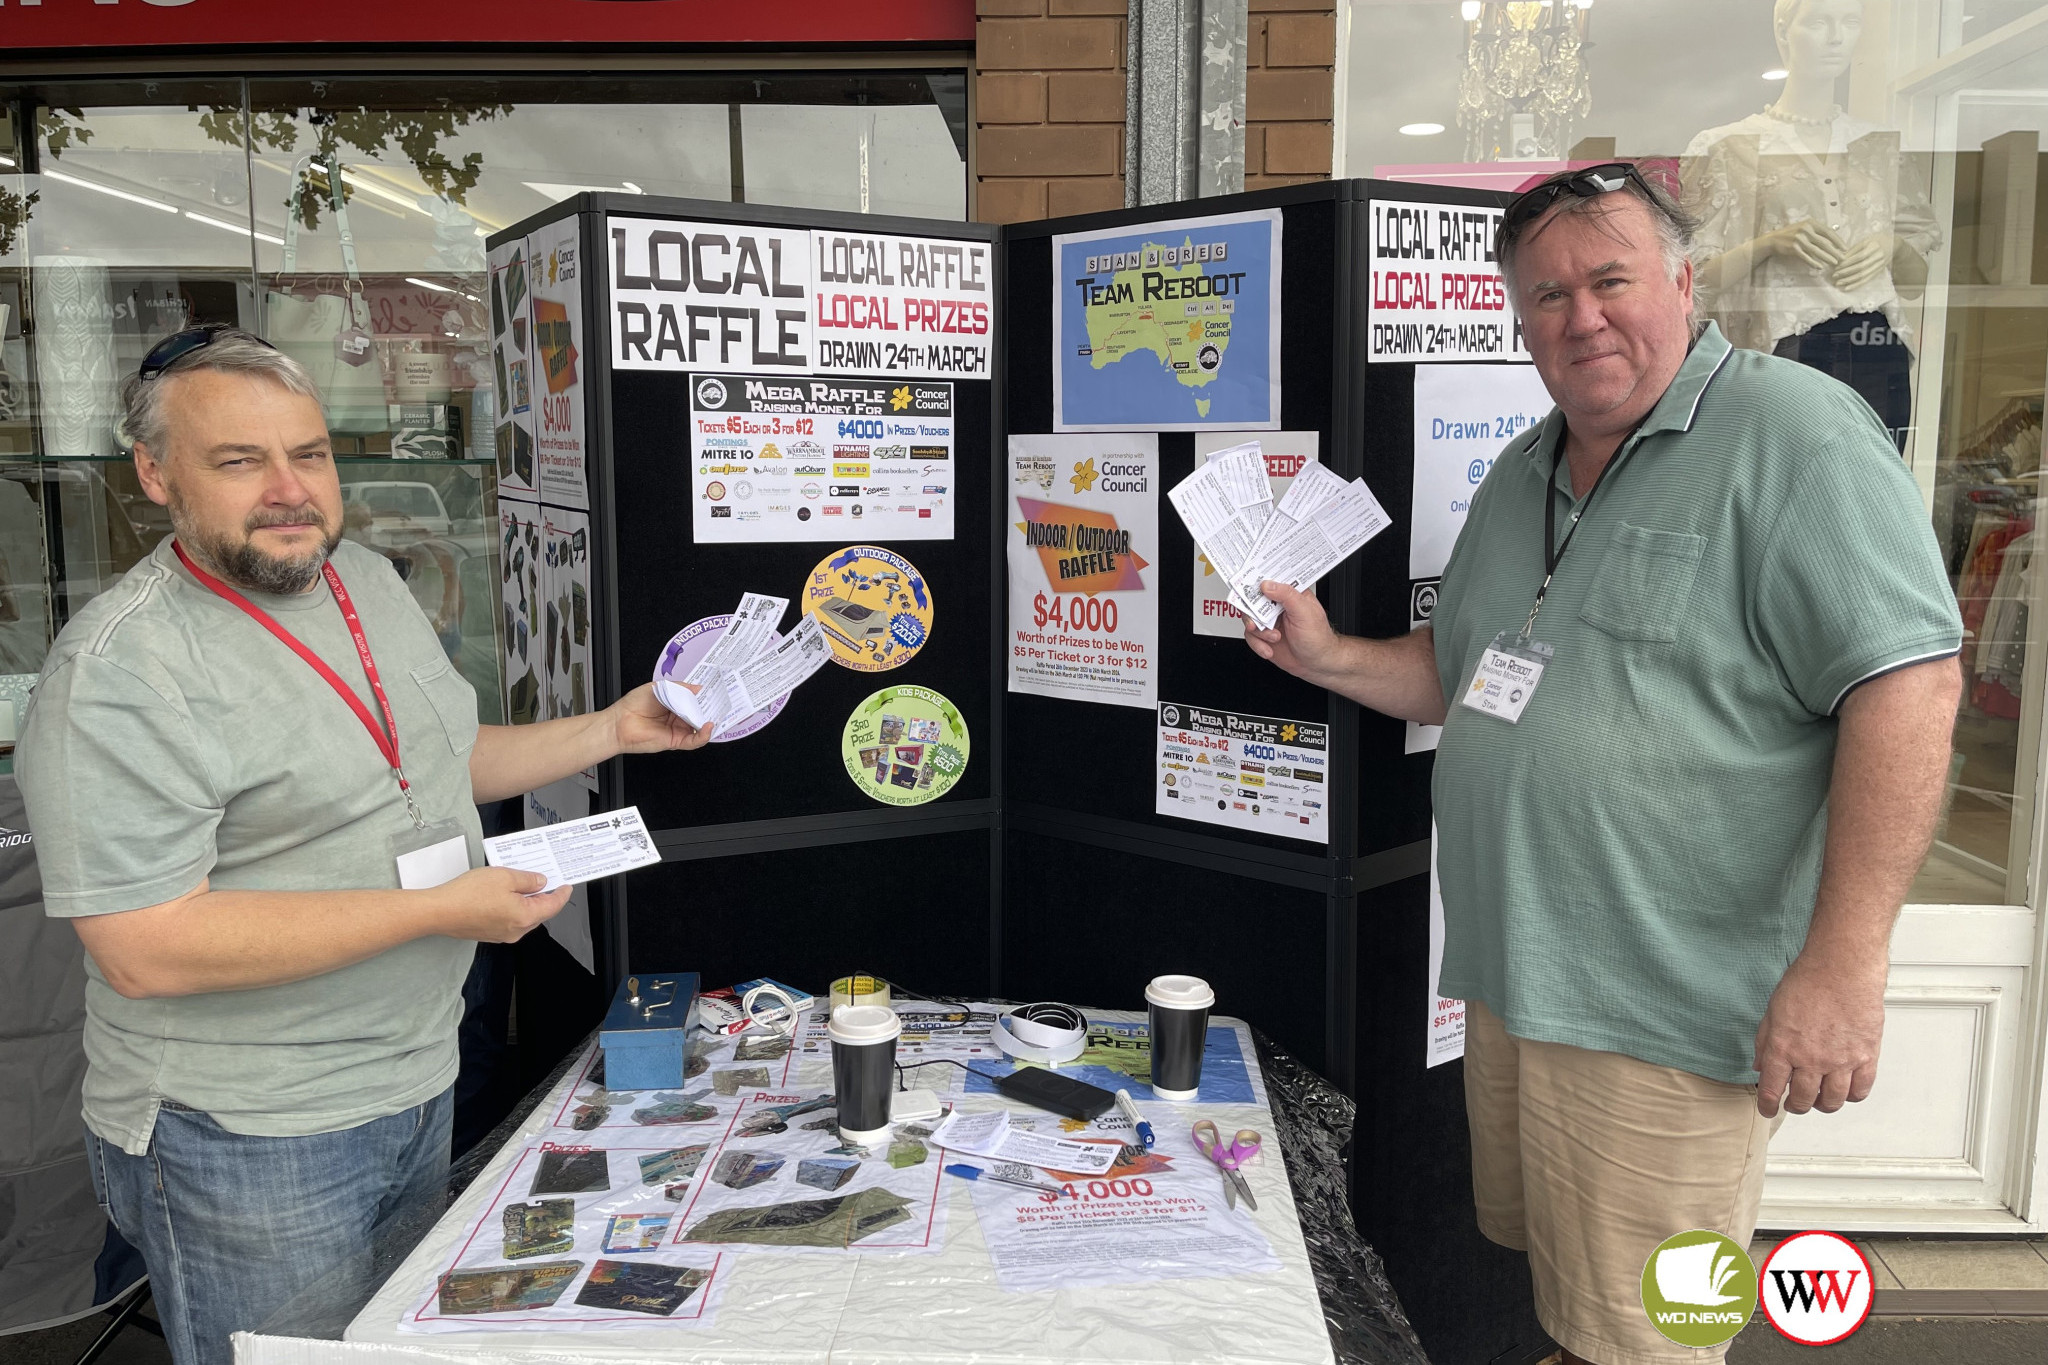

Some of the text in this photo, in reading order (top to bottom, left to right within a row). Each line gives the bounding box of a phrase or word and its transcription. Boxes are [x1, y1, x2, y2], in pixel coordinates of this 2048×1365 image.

[1375, 207, 1434, 260] LOCAL
[559, 249, 574, 264] Cancer
[612, 228, 804, 298] LOCAL
[818, 237, 985, 291] LOCAL RAFFLE
[1089, 246, 1223, 269] STAN & GREG
[559, 263, 575, 282] Council
[1076, 271, 1246, 306] TEAM REBOOT
[1374, 271, 1504, 311] LOCAL PRIZES
[817, 293, 988, 334] LOCAL PRIZES
[618, 301, 807, 367] RAFFLE
[1205, 321, 1229, 329] Cancer
[1205, 329, 1230, 338] Council
[1374, 323, 1422, 354] DRAWN
[1426, 324, 1455, 353] 24TH
[1458, 324, 1502, 353] MARCH
[819, 340, 985, 372] DRAWN 24TH MARCH
[745, 381, 805, 401] MEGA
[810, 383, 885, 403] RAFFLE
[915, 389, 948, 399] Cancer
[543, 393, 571, 435] $4,000
[751, 401, 882, 415] RAISING MONEY FOR
[915, 400, 949, 411] Council
[698, 416, 813, 435] TICKETS $5 EACH OR 3 FOR $12
[838, 419, 883, 439] $4000
[1432, 418, 1489, 439] Drawn
[1495, 412, 1526, 439] 24th
[701, 450, 736, 459] MITRE
[740, 450, 753, 459] 10
[1102, 462, 1146, 476] Cancer
[1102, 478, 1147, 492] Council
[1026, 520, 1129, 554] INDOOR OUTDOOR
[854, 548, 920, 581] OUTDOOR PACKAGE
[1059, 551, 1115, 579] RAFFLE
[814, 572, 828, 584] 1ST
[334, 587, 346, 602] WCC
[810, 586, 834, 600] PRIZE
[1034, 590, 1118, 633] $4,000
[674, 616, 734, 646] INDOOR PACKA
[892, 622, 918, 645] $2000
[1017, 630, 1144, 653] Worth of Prizes to be Won
[362, 652, 373, 669] WCC
[876, 662, 893, 670] LEAST
[1014, 646, 1147, 669] $5 Per Ticket or 3 for $12
[1491, 655, 1532, 676] TEAM REBOOT
[1481, 664, 1534, 686] RAISING MONEY FOR
[1484, 688, 1500, 697] Council
[1487, 681, 1502, 690] Cancer
[914, 689, 945, 707] PACKAGE
[1482, 699, 1497, 710] STAN
[851, 719, 869, 732] 3RD
[1189, 709, 1277, 735] MEGA RAFFLE
[1300, 726, 1324, 736] Cancer
[851, 731, 875, 747] PRIZE
[1192, 723, 1275, 744] RAISING MONEY FOR
[1299, 735, 1325, 745] Council
[1163, 752, 1193, 762] MITRE 10
[1243, 744, 1275, 761] $4000
[934, 756, 954, 772] $500
[873, 787, 895, 803] VOUCHERS
[921, 791, 935, 801] LEAST
[1434, 1011, 1465, 1028] $5 Per
[753, 1093, 801, 1103] PRIZES
[538, 1141, 591, 1154] PRIZES
[1016, 1204, 1060, 1215] Worth
[1063, 1203, 1078, 1211] of
[1081, 1201, 1124, 1210] Prizes
[1143, 1198, 1162, 1206] be
[1016, 1215, 1036, 1224] $5
[1039, 1214, 1066, 1222] Per
[1069, 1210, 1117, 1219] Ticket
[1178, 1205, 1208, 1213] $12
